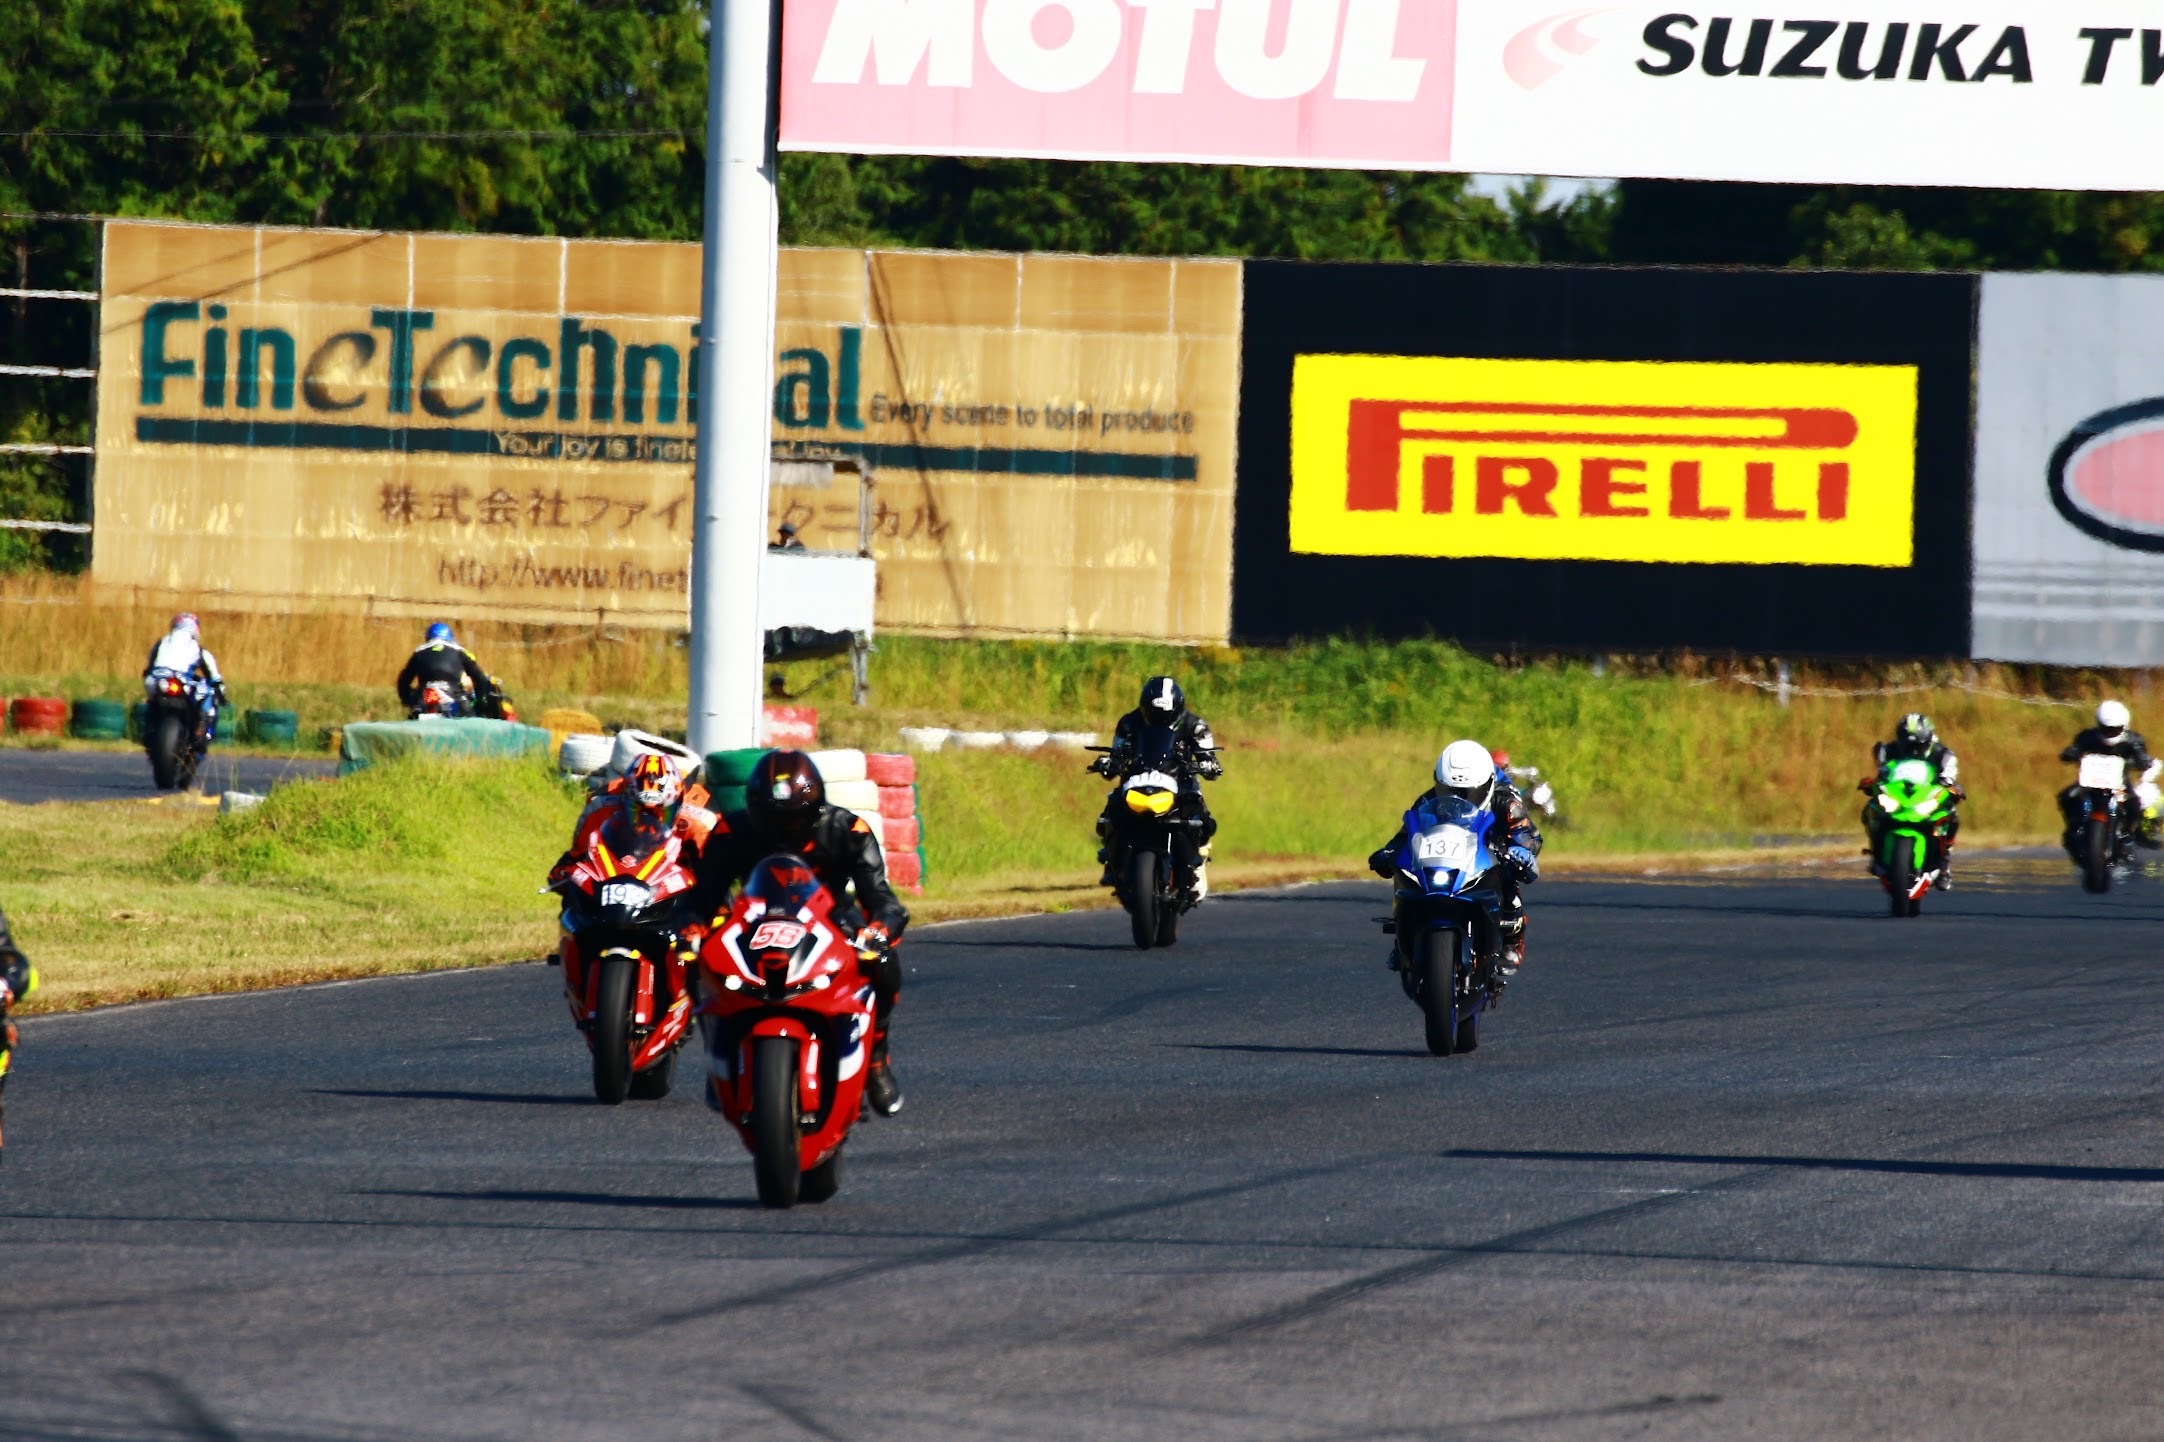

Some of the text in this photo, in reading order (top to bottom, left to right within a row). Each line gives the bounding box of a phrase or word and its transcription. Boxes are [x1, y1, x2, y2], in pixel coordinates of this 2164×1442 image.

[812, 0, 1427, 103] MOTUL
[1635, 12, 2033, 84] SUZUKA
[139, 300, 865, 431] FineTechnal
[871, 394, 933, 433] Every
[1015, 402, 1037, 427] to
[1044, 401, 1095, 432] total
[1346, 398, 1858, 521] PIRELLI
[380, 482, 952, 540] 株式会社ファイクニカル
[1425, 839, 1460, 857] 137
